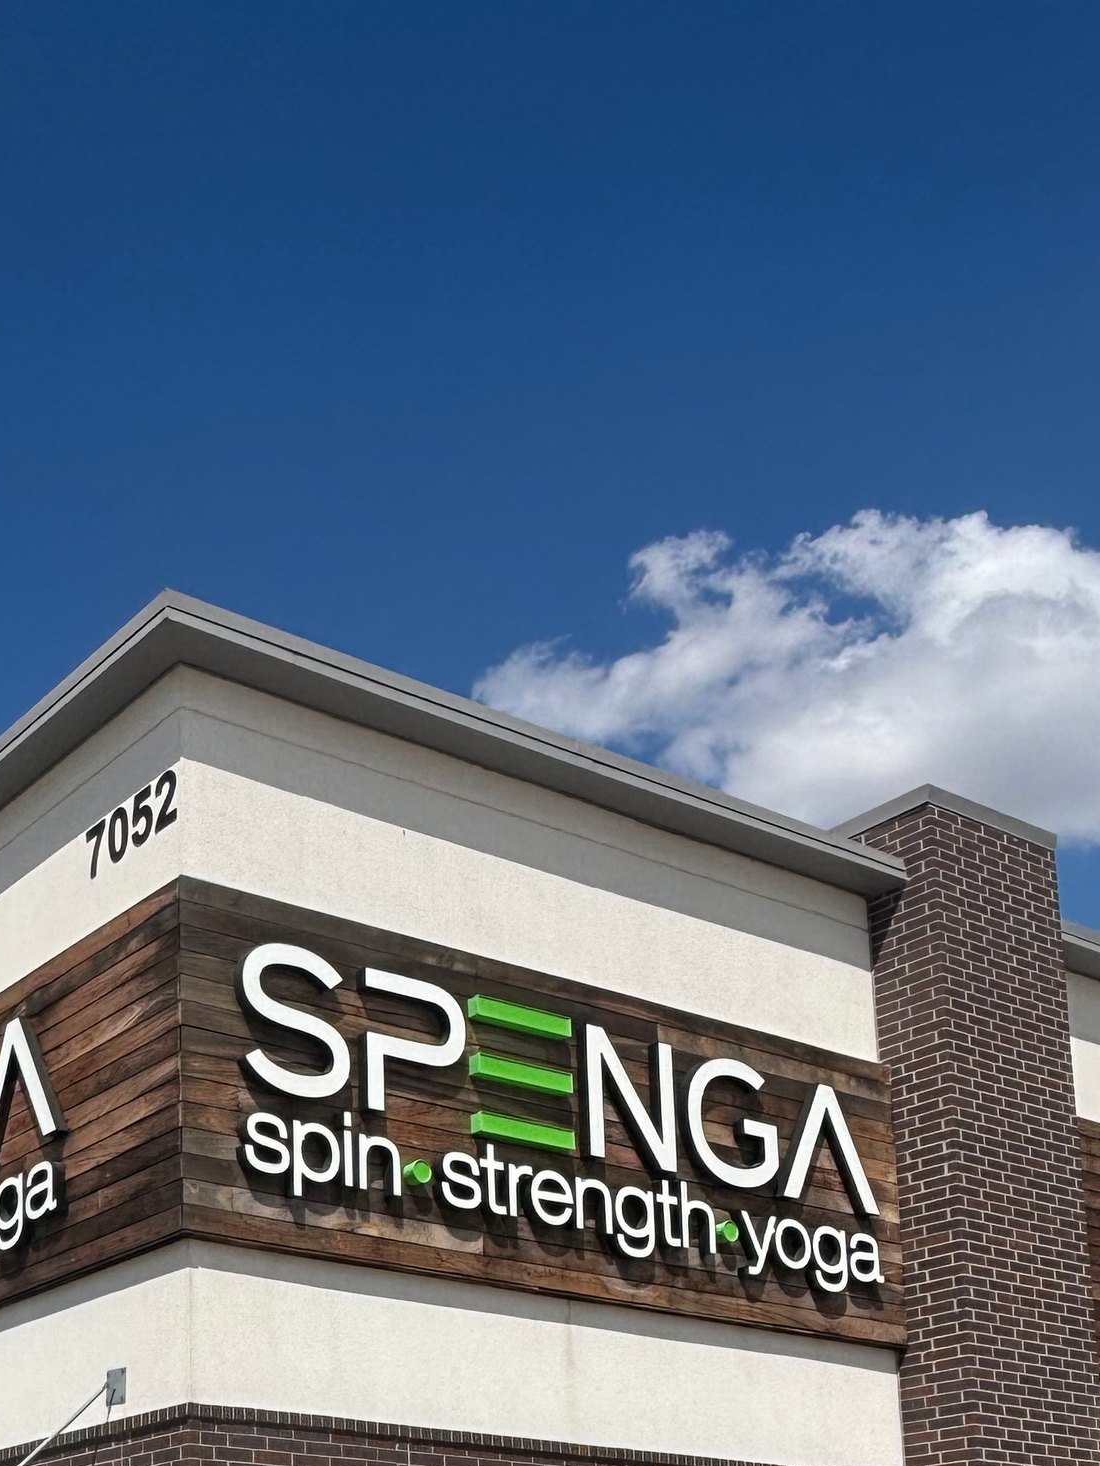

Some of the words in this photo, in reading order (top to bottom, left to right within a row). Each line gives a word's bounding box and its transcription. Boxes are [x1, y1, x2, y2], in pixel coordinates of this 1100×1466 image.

[85, 769, 178, 880] 7052
[239, 942, 881, 1216] SPENGA
[244, 1110, 403, 1196] spin
[440, 1143, 718, 1259] strength
[738, 1207, 886, 1294] yoga
